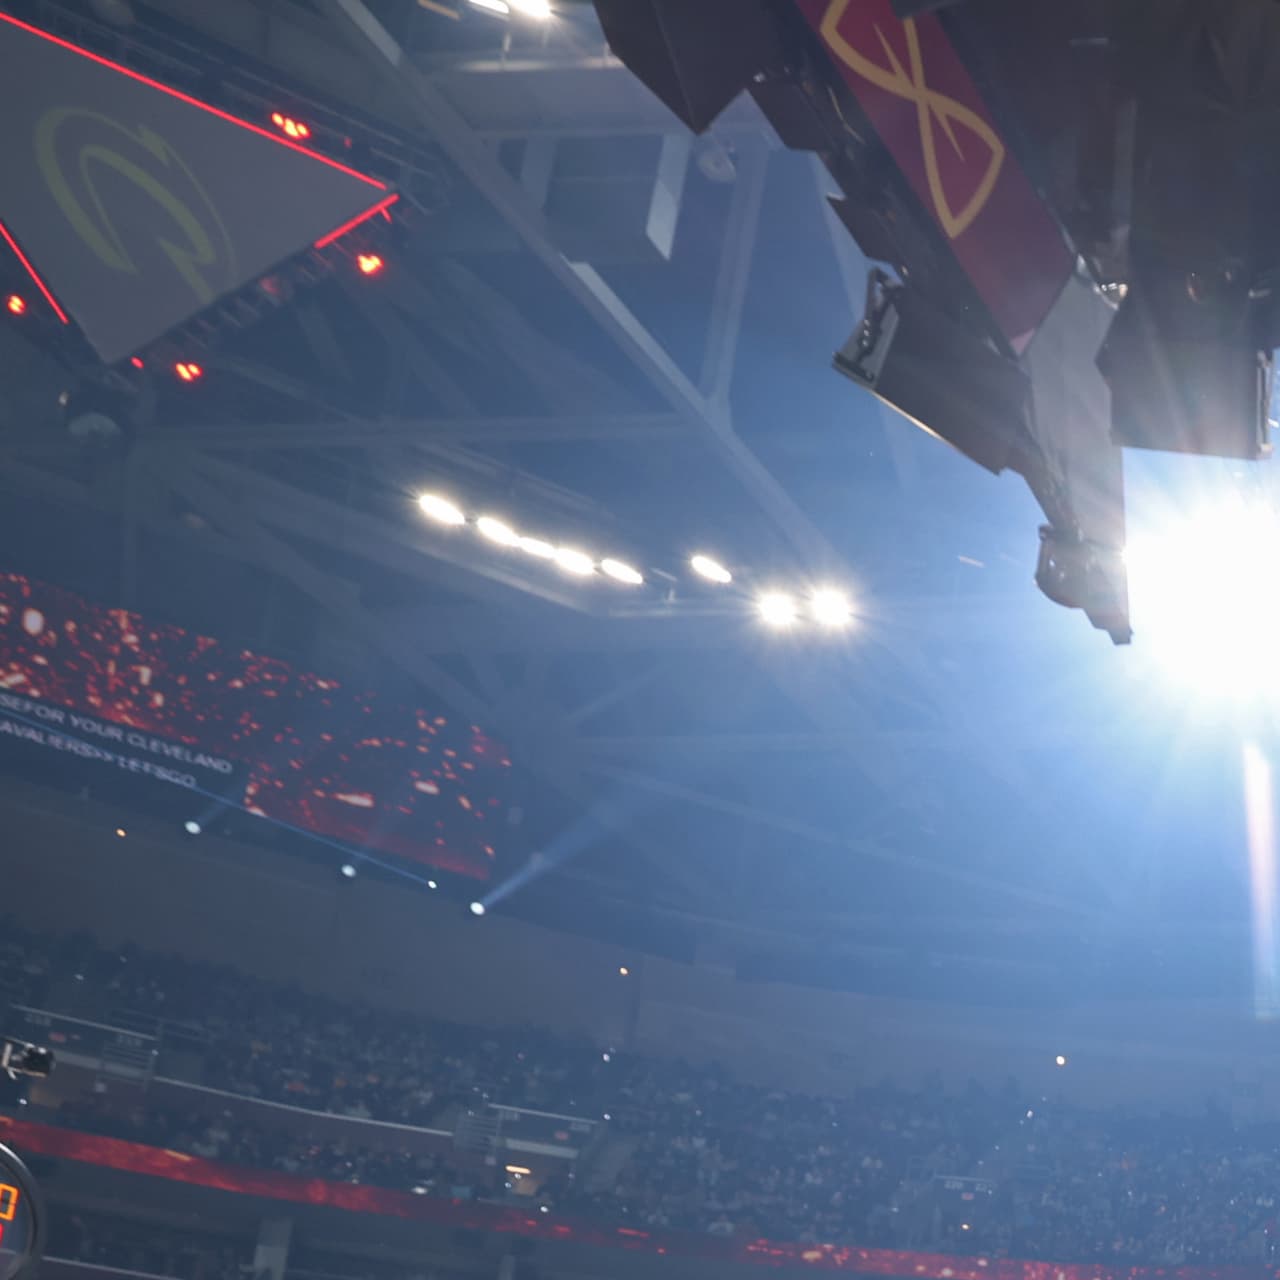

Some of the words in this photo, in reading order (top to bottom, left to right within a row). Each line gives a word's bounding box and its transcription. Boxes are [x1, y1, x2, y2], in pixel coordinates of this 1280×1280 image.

[0, 720, 95, 759] AVALIERS
[69, 713, 125, 743] YOUR
[126, 732, 234, 776] CLEVELAND
